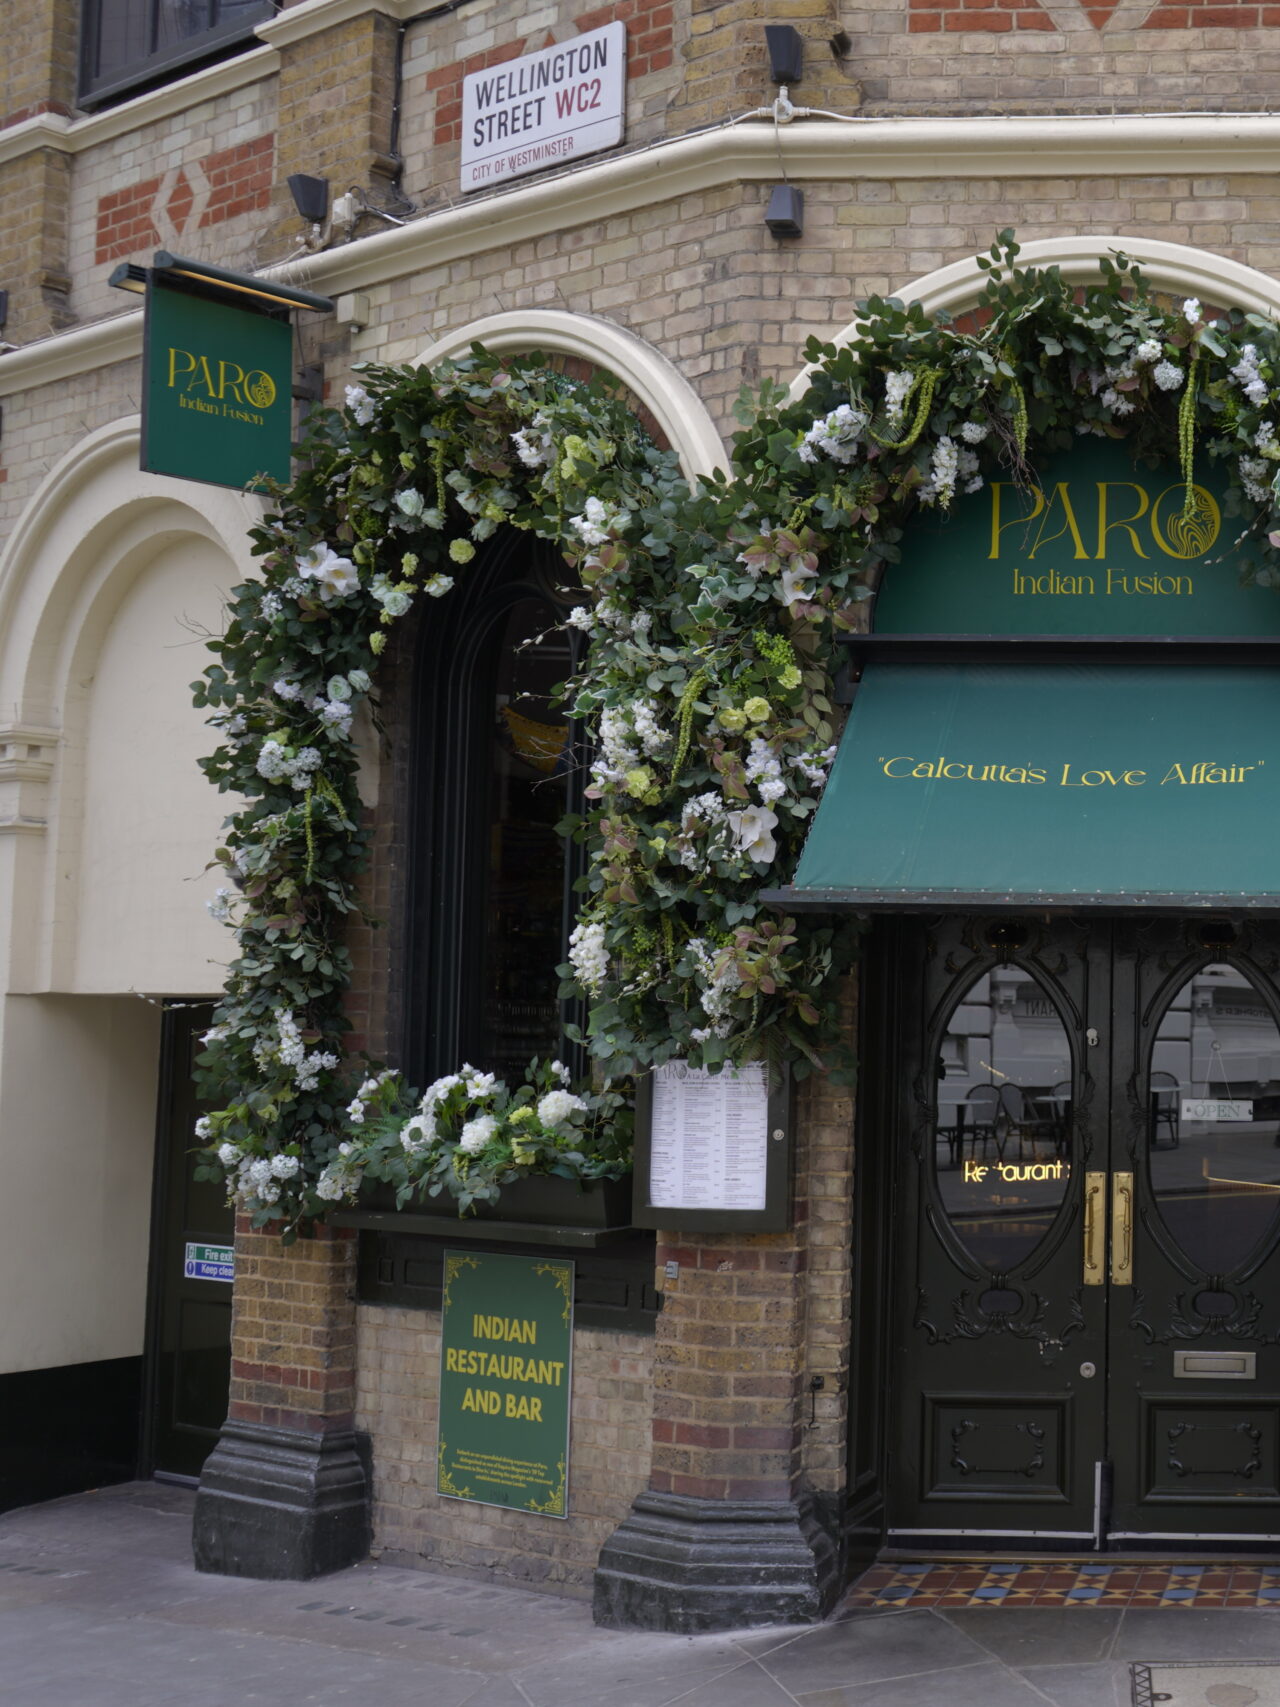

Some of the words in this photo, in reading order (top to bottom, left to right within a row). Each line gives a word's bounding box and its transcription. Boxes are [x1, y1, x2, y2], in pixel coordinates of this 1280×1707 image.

[475, 37, 608, 110] WELLINGTON
[473, 96, 546, 148] STREET
[555, 78, 602, 120] WC2
[472, 163, 492, 181] CITY
[495, 160, 506, 174] OF
[508, 136, 574, 169] WESTMINSTER
[167, 347, 276, 409] PARO
[179, 393, 219, 416] Indian
[222, 403, 264, 426] Fusion
[986, 481, 1221, 560] PARO
[1012, 568, 1095, 595] Indian
[1105, 568, 1193, 595] Fusion
[1059, 763, 1147, 786] Love
[1160, 760, 1265, 785] Affair"
[1194, 1104, 1240, 1118] OPEN
[201, 1264, 218, 1277] Keep
[204, 1248, 219, 1261] Fire
[220, 1250, 233, 1262] exit
[473, 1314, 537, 1345] INDIAN
[446, 1347, 564, 1387] RESTAURANT
[461, 1387, 501, 1415] AND
[505, 1393, 543, 1423] BAR
